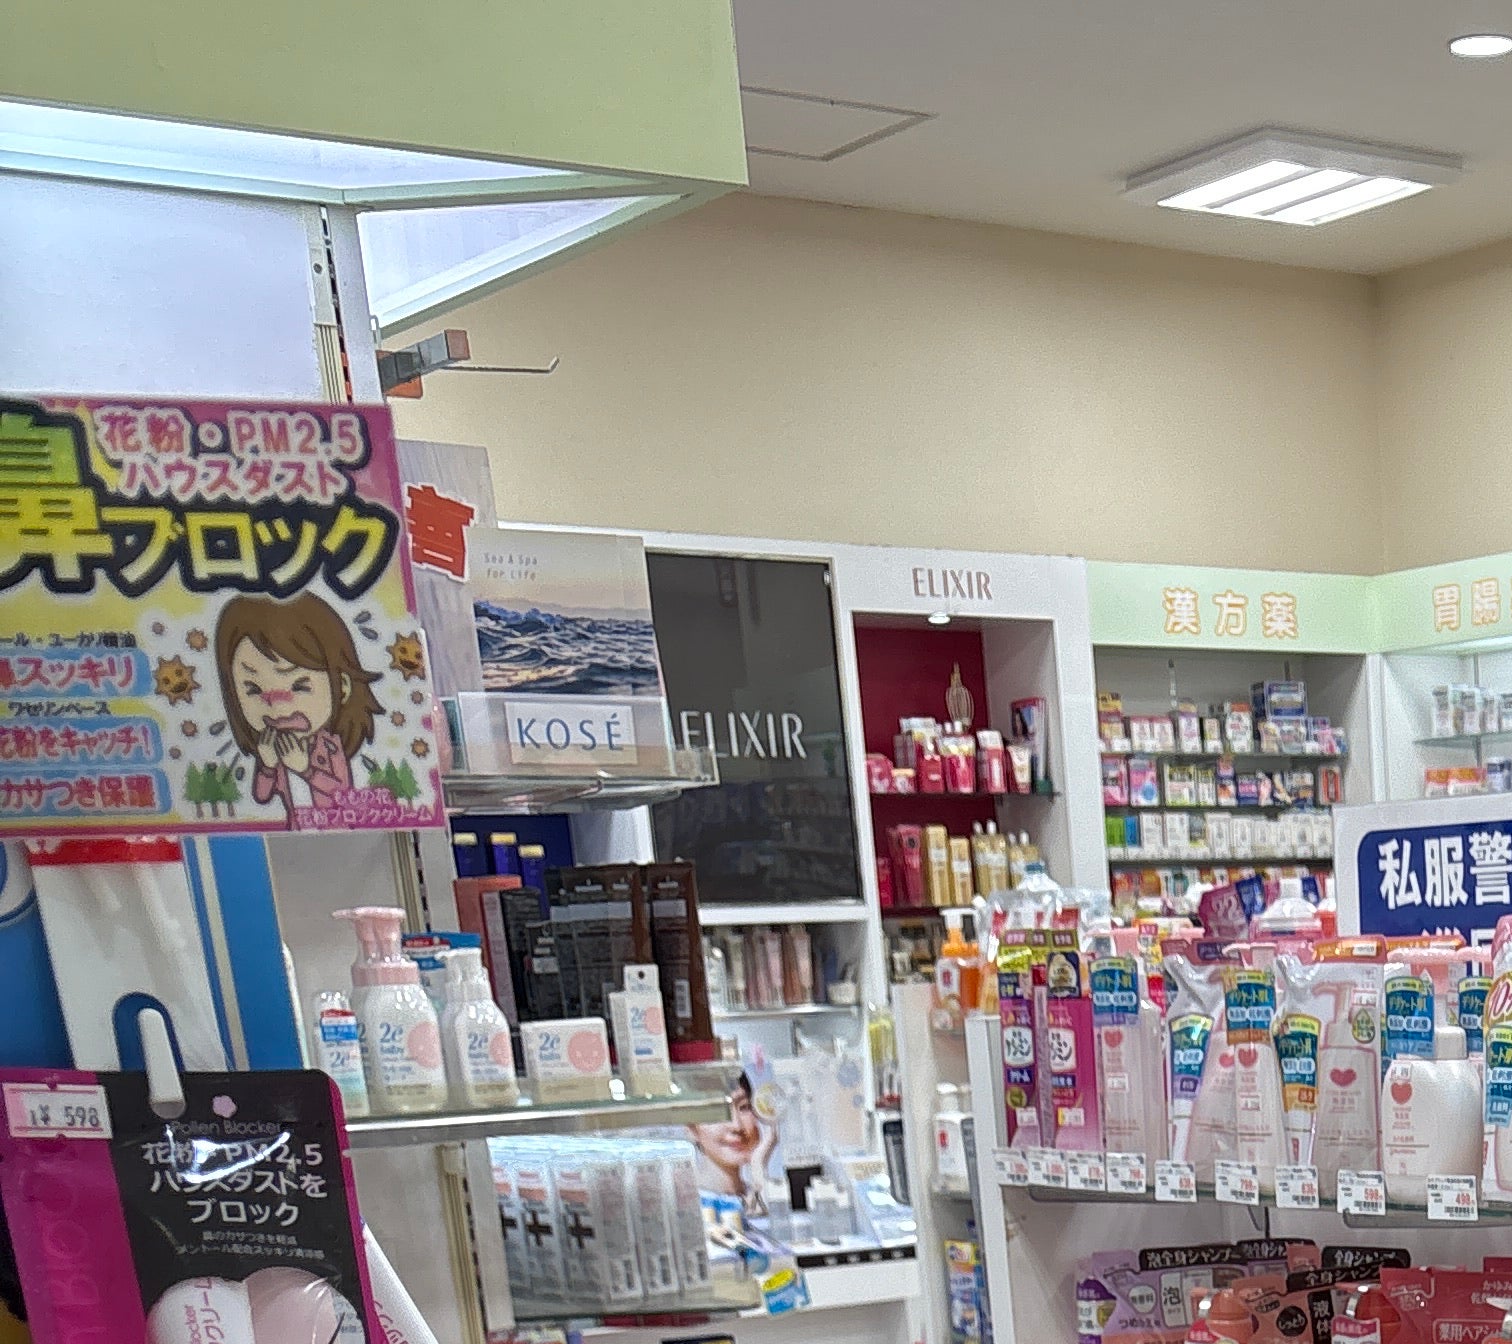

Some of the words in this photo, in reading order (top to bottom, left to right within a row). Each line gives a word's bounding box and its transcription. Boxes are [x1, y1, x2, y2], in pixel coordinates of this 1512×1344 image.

[122, 459, 347, 498] ハウスダスト
[911, 567, 993, 600] ELIXIR
[1164, 586, 1299, 638] 漢方薬
[517, 714, 624, 750] KOSÉ
[188, 1199, 299, 1226] ブロック
